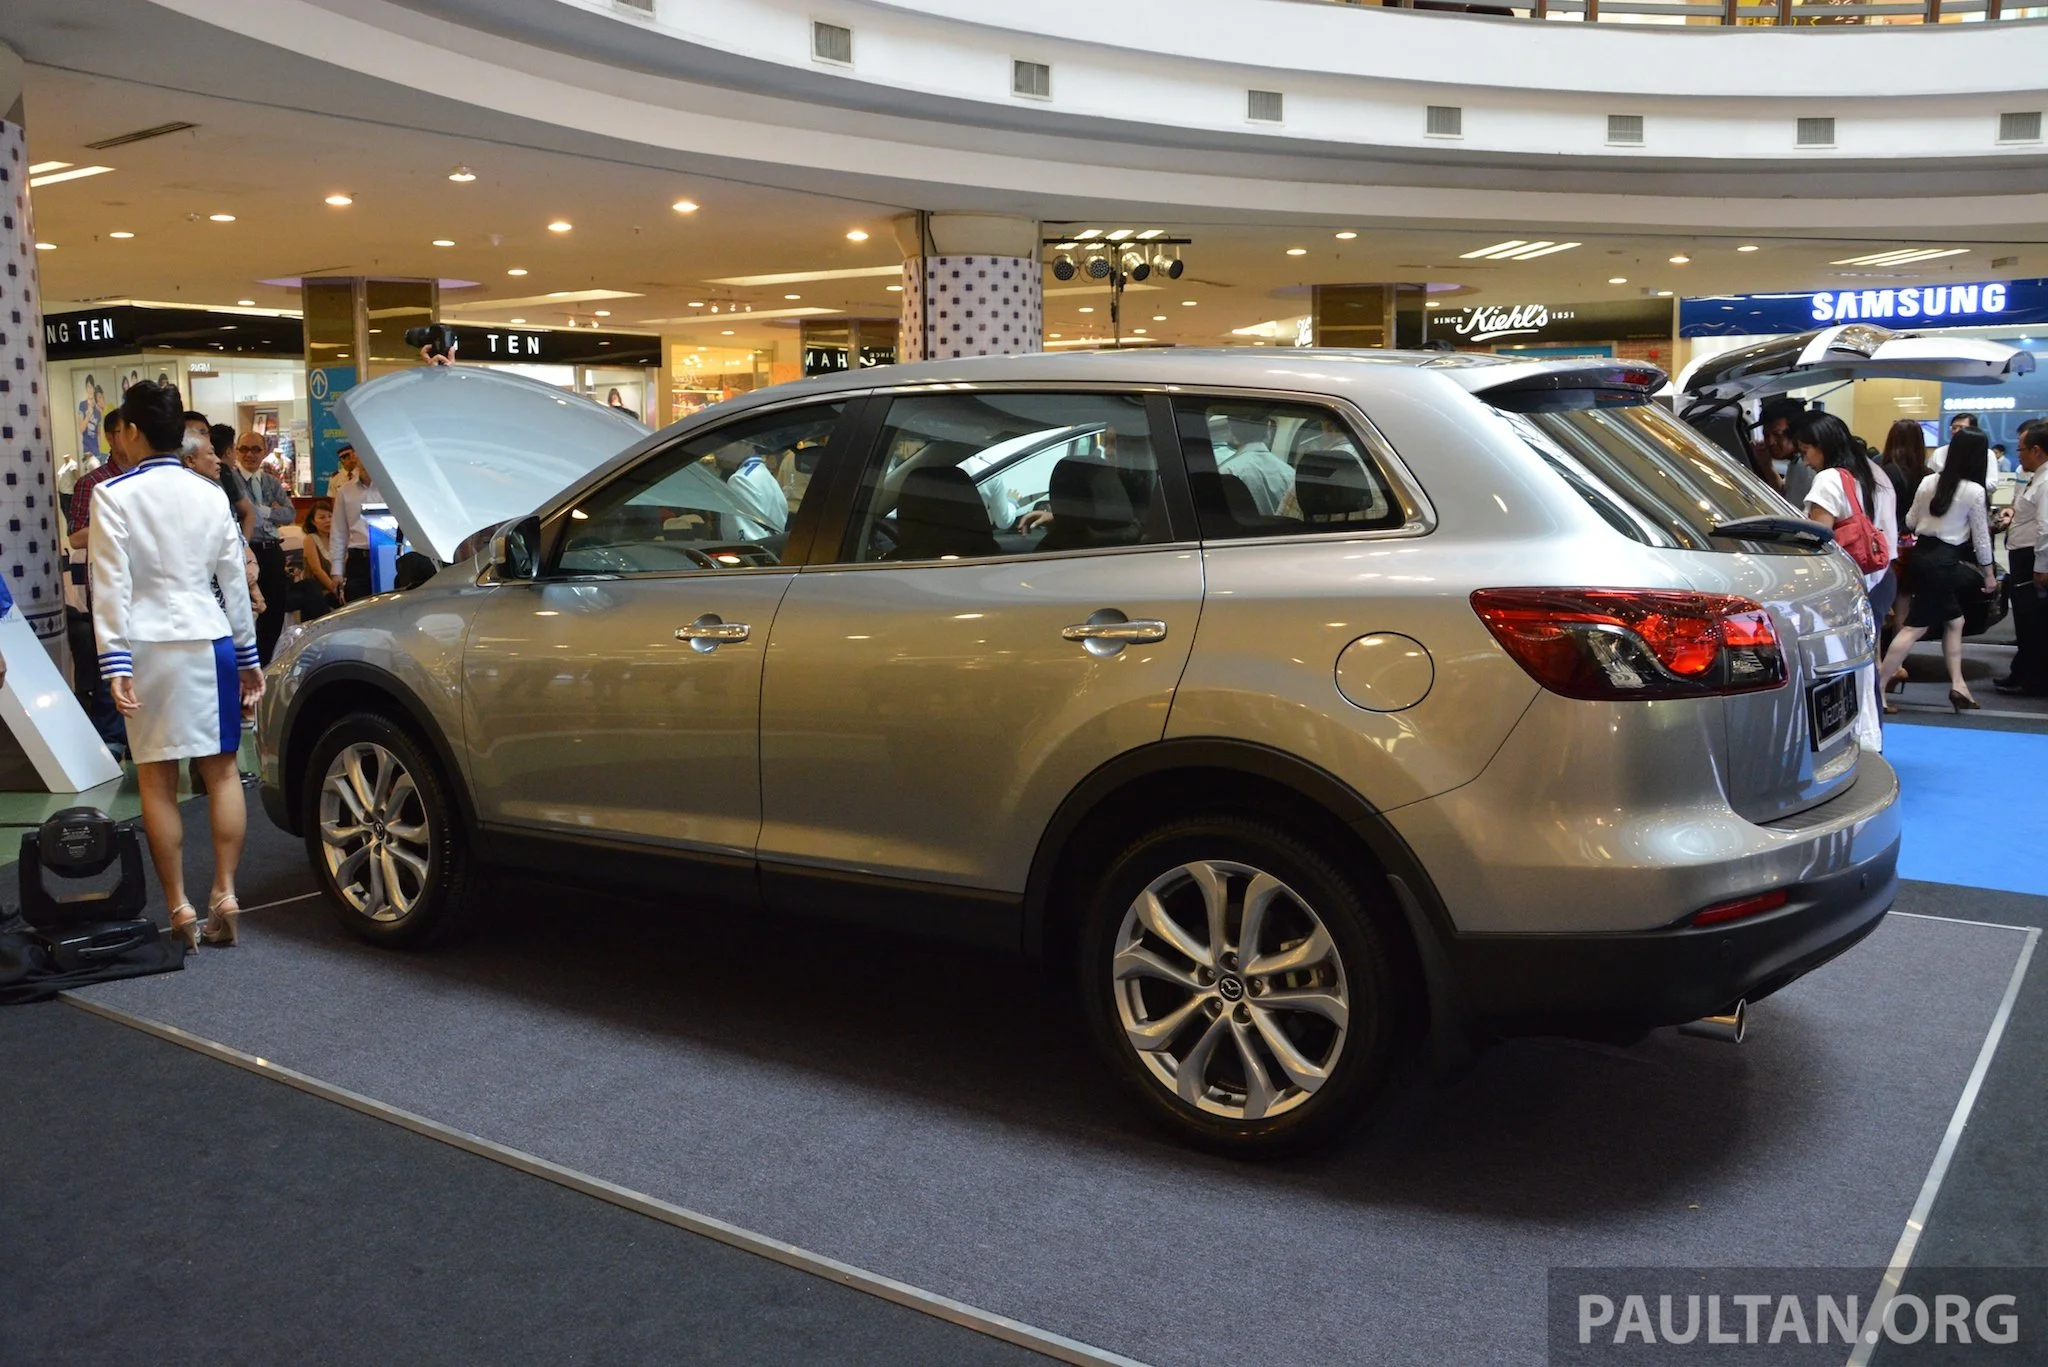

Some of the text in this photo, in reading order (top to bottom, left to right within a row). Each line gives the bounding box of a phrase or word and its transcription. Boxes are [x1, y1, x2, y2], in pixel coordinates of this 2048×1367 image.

[1811, 283, 2006, 321] SAMSUNG
[46, 318, 115, 344] NG TEN
[1433, 304, 1575, 335] SINCE Kiehl's 1851
[487, 334, 540, 355] TEN
[1943, 397, 2016, 411] SAMSUNG
